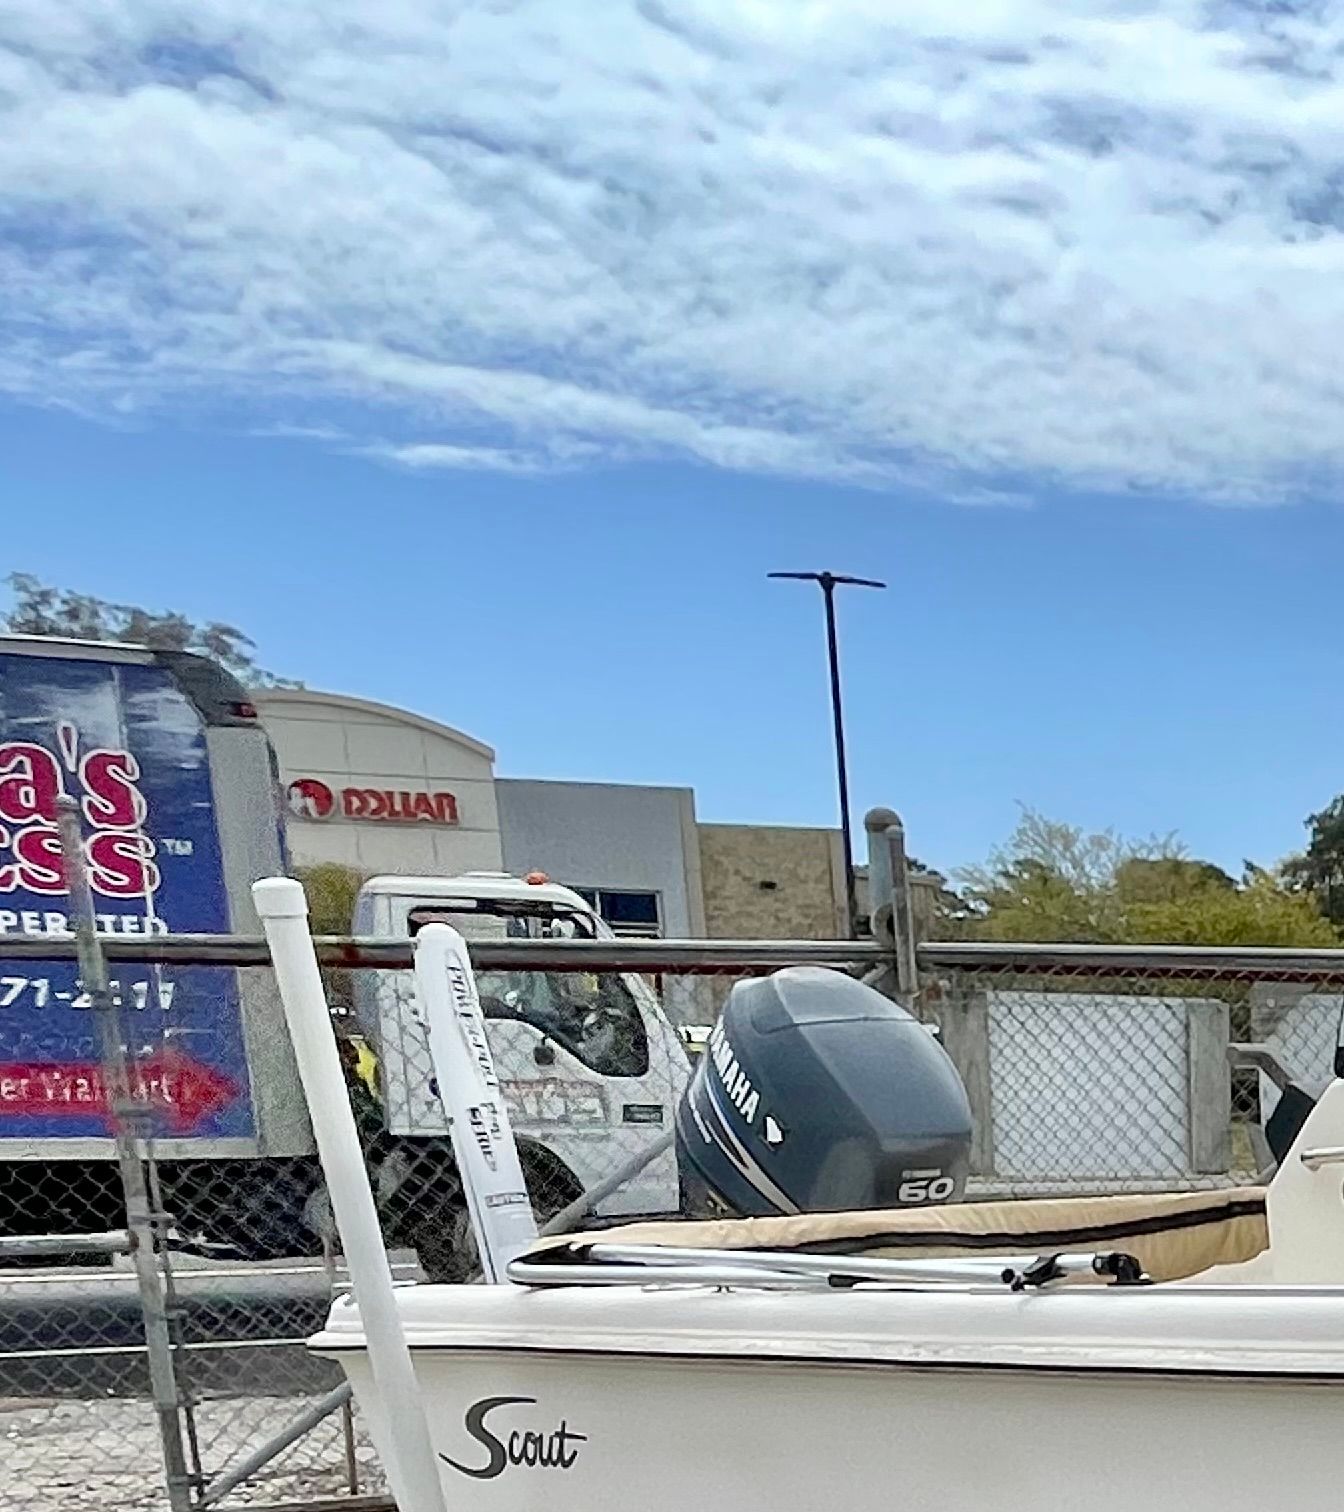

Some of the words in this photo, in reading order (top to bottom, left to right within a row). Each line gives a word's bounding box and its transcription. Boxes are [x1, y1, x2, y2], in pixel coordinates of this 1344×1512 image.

[340, 787, 460, 826] DOLLAR
[0, 910, 169, 937] PERTED
[710, 1014, 760, 1124] YAMAHA
[898, 1177, 955, 1202] 60
[438, 1396, 588, 1479] Scout
